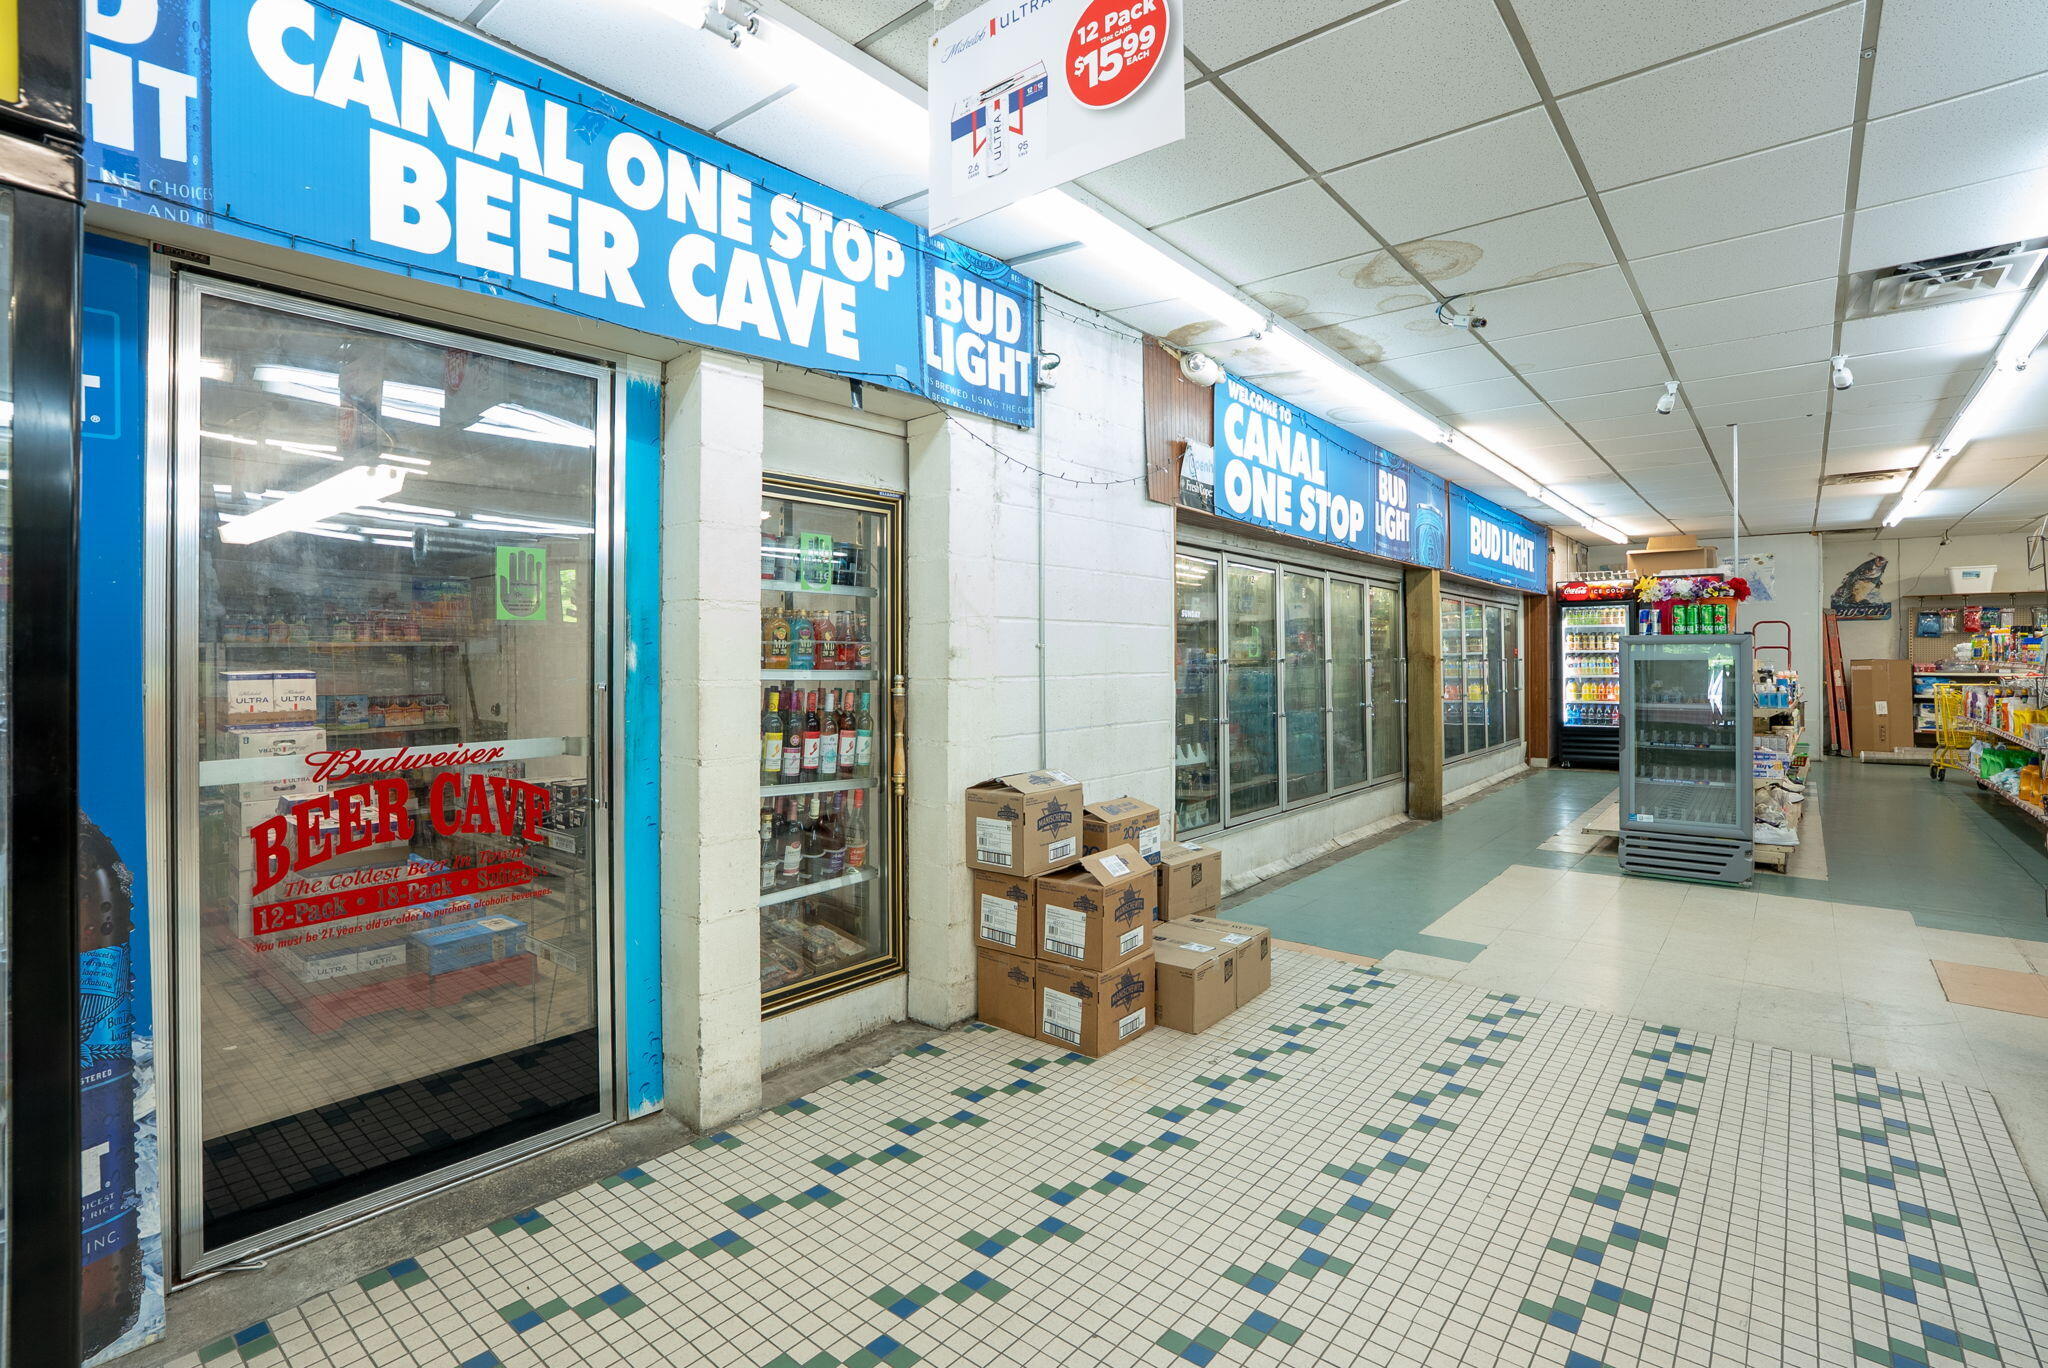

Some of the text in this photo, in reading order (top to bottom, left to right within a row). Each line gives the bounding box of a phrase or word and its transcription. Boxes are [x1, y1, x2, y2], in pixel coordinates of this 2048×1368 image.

[1077, 0, 1156, 45] 12 Pack
[1126, 50, 1150, 66] EACH
[247, 0, 584, 189] CANAL
[607, 132, 752, 240] ONE
[769, 191, 905, 291] STOP
[993, 113, 1002, 161] ULTRA
[369, 128, 861, 362] BEER CAVE
[934, 266, 1022, 345] BUD
[924, 315, 1032, 397] LIGHT
[935, 379, 968, 400] BREWED
[971, 393, 999, 409] USING
[1002, 402, 1016, 413] THE
[1227, 378, 1292, 425] WELCOME TO
[1223, 402, 1326, 487] CANAL
[1224, 458, 1365, 543] ONE STOP
[1378, 468, 1407, 509] BUD
[1375, 500, 1411, 542] LIGHT
[1469, 515, 1535, 573] BUD LIGHT
[1564, 586, 1588, 595] Coca-Cola
[280, 695, 312, 703] ULTRA
[305, 743, 505, 784] Budweiser
[250, 771, 550, 898] BEER CAVE
[284, 879, 322, 898] The
[329, 866, 402, 890] Coldest
[407, 857, 450, 877] Beer
[254, 943, 274, 953] You
[278, 935, 303, 948] must
[305, 931, 319, 943] be
[336, 924, 363, 938] years
[365, 918, 381, 931] old
[383, 916, 394, 927] or
[396, 911, 420, 924] older
[422, 909, 431, 920] to
[433, 902, 472, 919] purchase
[473, 895, 510, 909] alcoholic
[259, 896, 349, 932] 12-Pack
[376, 878, 454, 907] 18-Pack
[369, 955, 398, 967] ULTRA
[90, 1203, 116, 1219] RICE
[87, 1230, 120, 1254] INC.
